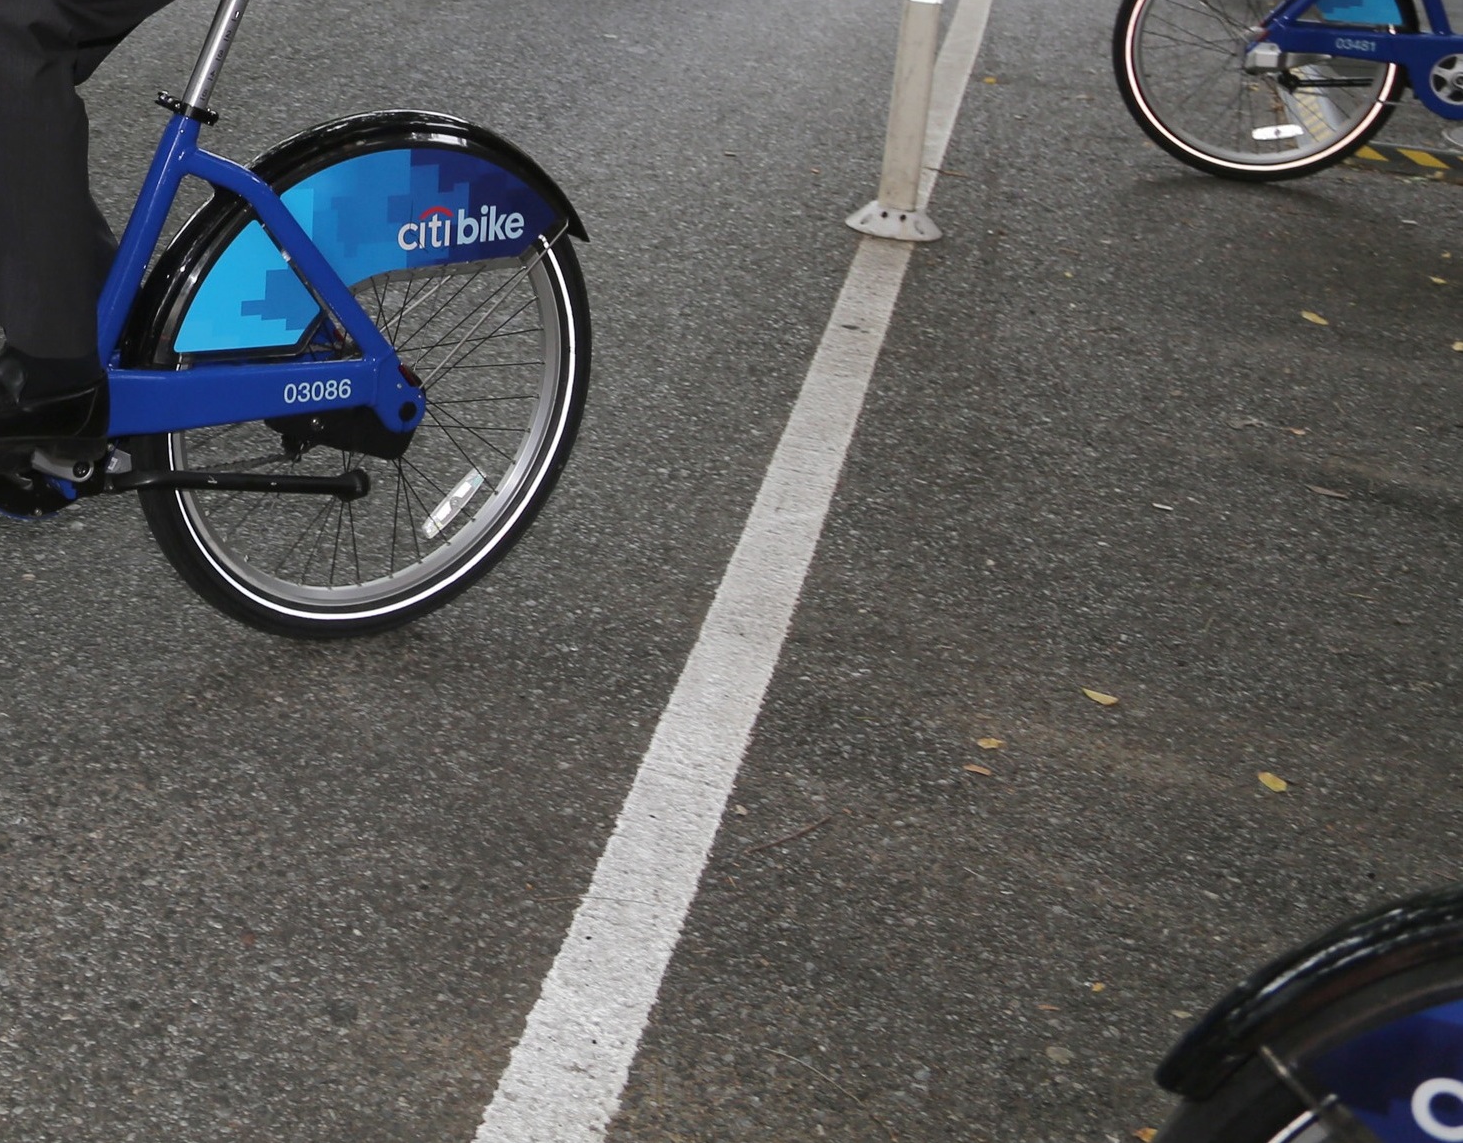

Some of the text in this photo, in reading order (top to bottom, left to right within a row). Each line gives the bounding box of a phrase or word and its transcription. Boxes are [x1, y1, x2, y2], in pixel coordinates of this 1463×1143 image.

[1334, 37, 1377, 52] 03481
[398, 204, 525, 251] citi bike
[283, 379, 352, 404] 03086
